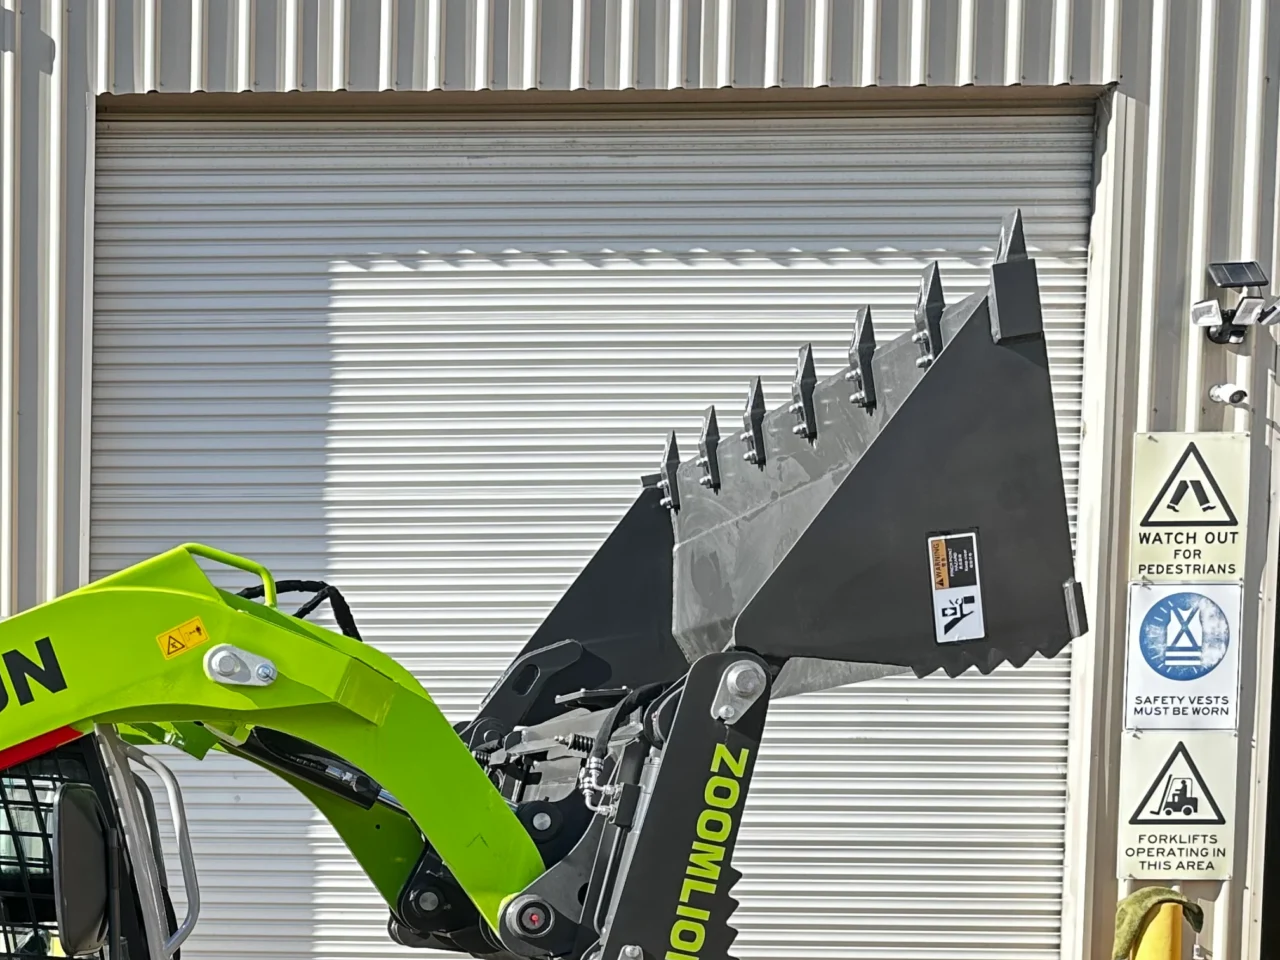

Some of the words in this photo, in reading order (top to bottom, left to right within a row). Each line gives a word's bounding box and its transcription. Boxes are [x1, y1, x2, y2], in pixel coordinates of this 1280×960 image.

[1138, 532, 1197, 544] WATCH
[1204, 531, 1239, 544] OUT
[1173, 549, 1202, 559] FOR
[933, 543, 942, 578] WARNING
[1138, 564, 1236, 574] PEDESTRIANS
[1134, 696, 1185, 705] SAFETY
[1188, 696, 1229, 705] VESTS
[1133, 707, 1170, 715] MUST
[1172, 707, 1189, 715] BE
[1192, 707, 1229, 715] WORN
[1138, 834, 1218, 844] FORKLIFTS
[1125, 847, 1209, 857] OPERATING
[1212, 847, 1226, 857] IN
[1139, 861, 1172, 870] THIS
[1175, 861, 1215, 870] AREA
